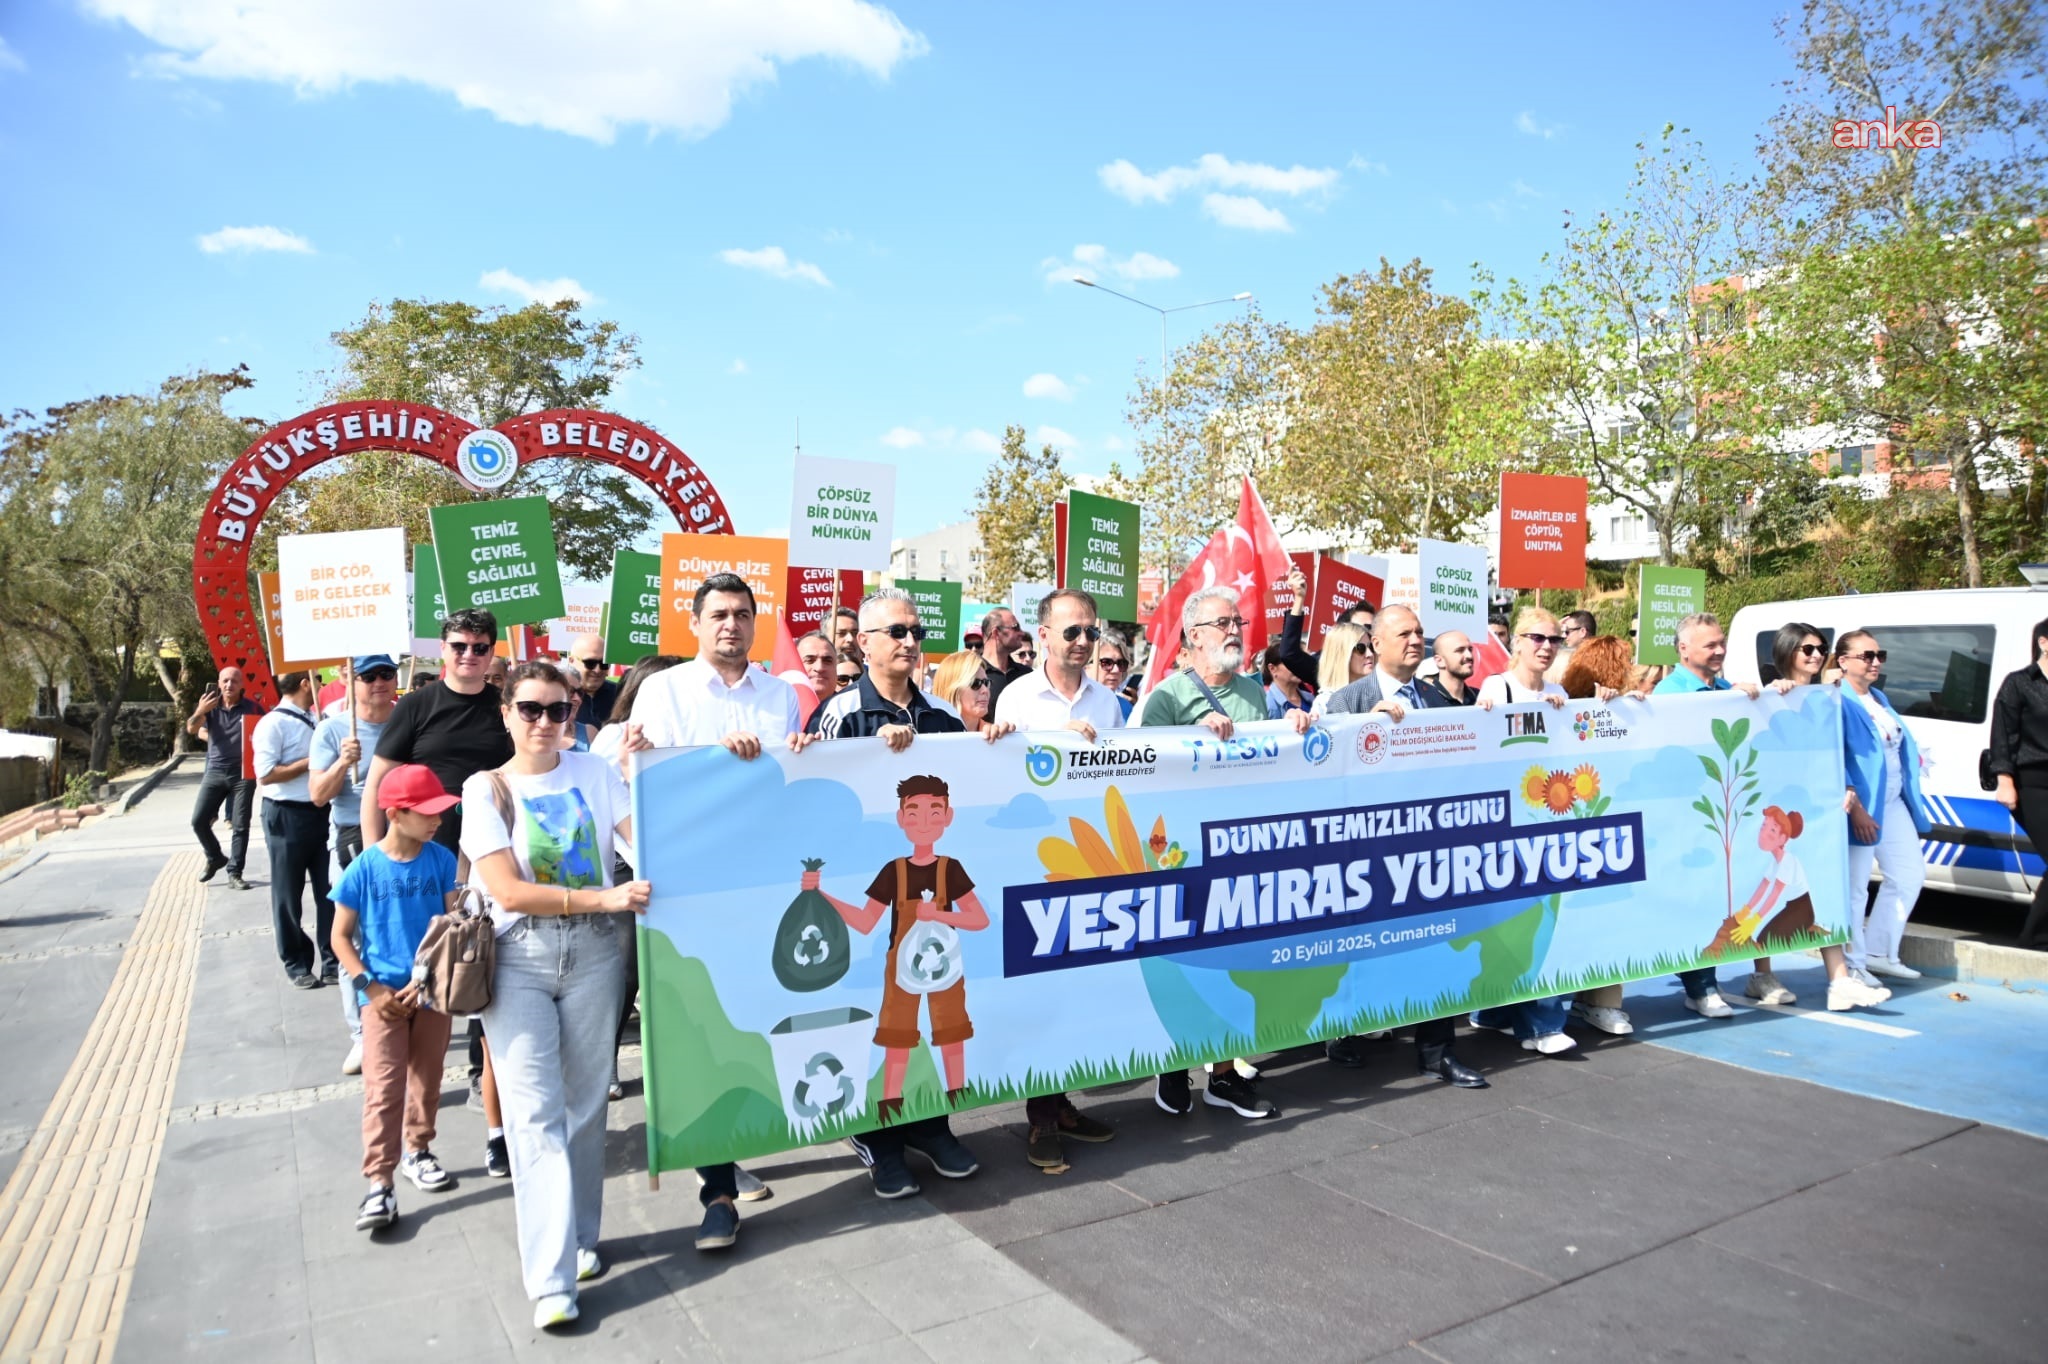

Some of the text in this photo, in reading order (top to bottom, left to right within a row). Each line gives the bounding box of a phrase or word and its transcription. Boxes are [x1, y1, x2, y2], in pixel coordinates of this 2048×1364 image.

[217, 409, 724, 542] BÜYÜKŞEHİR BELEDİYESİ
[817, 485, 871, 503] ÇÖPSÜZ
[806, 503, 878, 523] BİR DÜNYA
[1511, 508, 1577, 523] İZMARİTLER DE
[470, 520, 519, 540] TEMİZ
[812, 524, 871, 541] MÜMKÜN
[1091, 517, 1119, 535] TEMİZ
[1525, 524, 1563, 538] ÇÖPTÜR,
[471, 542, 527, 564] ÇEVRE,
[1087, 537, 1121, 558] ÇEVRE,
[1525, 540, 1563, 552] UNUTMA
[311, 567, 335, 581] BİR
[467, 562, 537, 584] SAĞLIKLI
[679, 557, 771, 576] DÜNYA BİZE
[803, 568, 833, 581] ÇEVR
[1082, 557, 1125, 577] SAĞLIKLI
[1436, 565, 1472, 582] ÇÖPSÜZ
[295, 583, 391, 601] BİR GELECEK
[471, 582, 540, 606] GELECEK
[673, 576, 701, 591] MİR
[748, 579, 775, 597] ĞİL,
[800, 580, 843, 593] SEVGİİ
[1081, 578, 1124, 597] GELECEK
[1337, 580, 1366, 600] ÇEVRE
[1430, 581, 1445, 594] BİR
[1447, 584, 1479, 599] DÜNYA
[1654, 584, 1692, 597] GELECEK
[914, 592, 942, 603] TEMİZ
[1274, 594, 1296, 604] VATA
[1651, 600, 1675, 613] NESİL
[312, 603, 377, 620] EKSİLTİR
[915, 605, 943, 616] EVRE,
[1434, 599, 1475, 615] MÜMKÜN
[1654, 616, 1678, 630] ÇÖPÜ
[1593, 709, 1611, 718] Let's
[1505, 711, 1546, 736] TEMA
[1594, 727, 1628, 739] Türkiye
[1069, 744, 1157, 767] TEKİRDAĞ
[1067, 765, 1156, 780] BÜYÜKŞEHİR BELEDİYESİ
[1209, 797, 1505, 857] DÜNYA TEMİZLİK GÜNÜ
[1021, 825, 1635, 957] YEŞİL MİRAS YÜRÜYÜŞÜ
[1271, 918, 1457, 964] 20 Eylül 2025, Cumartesi
